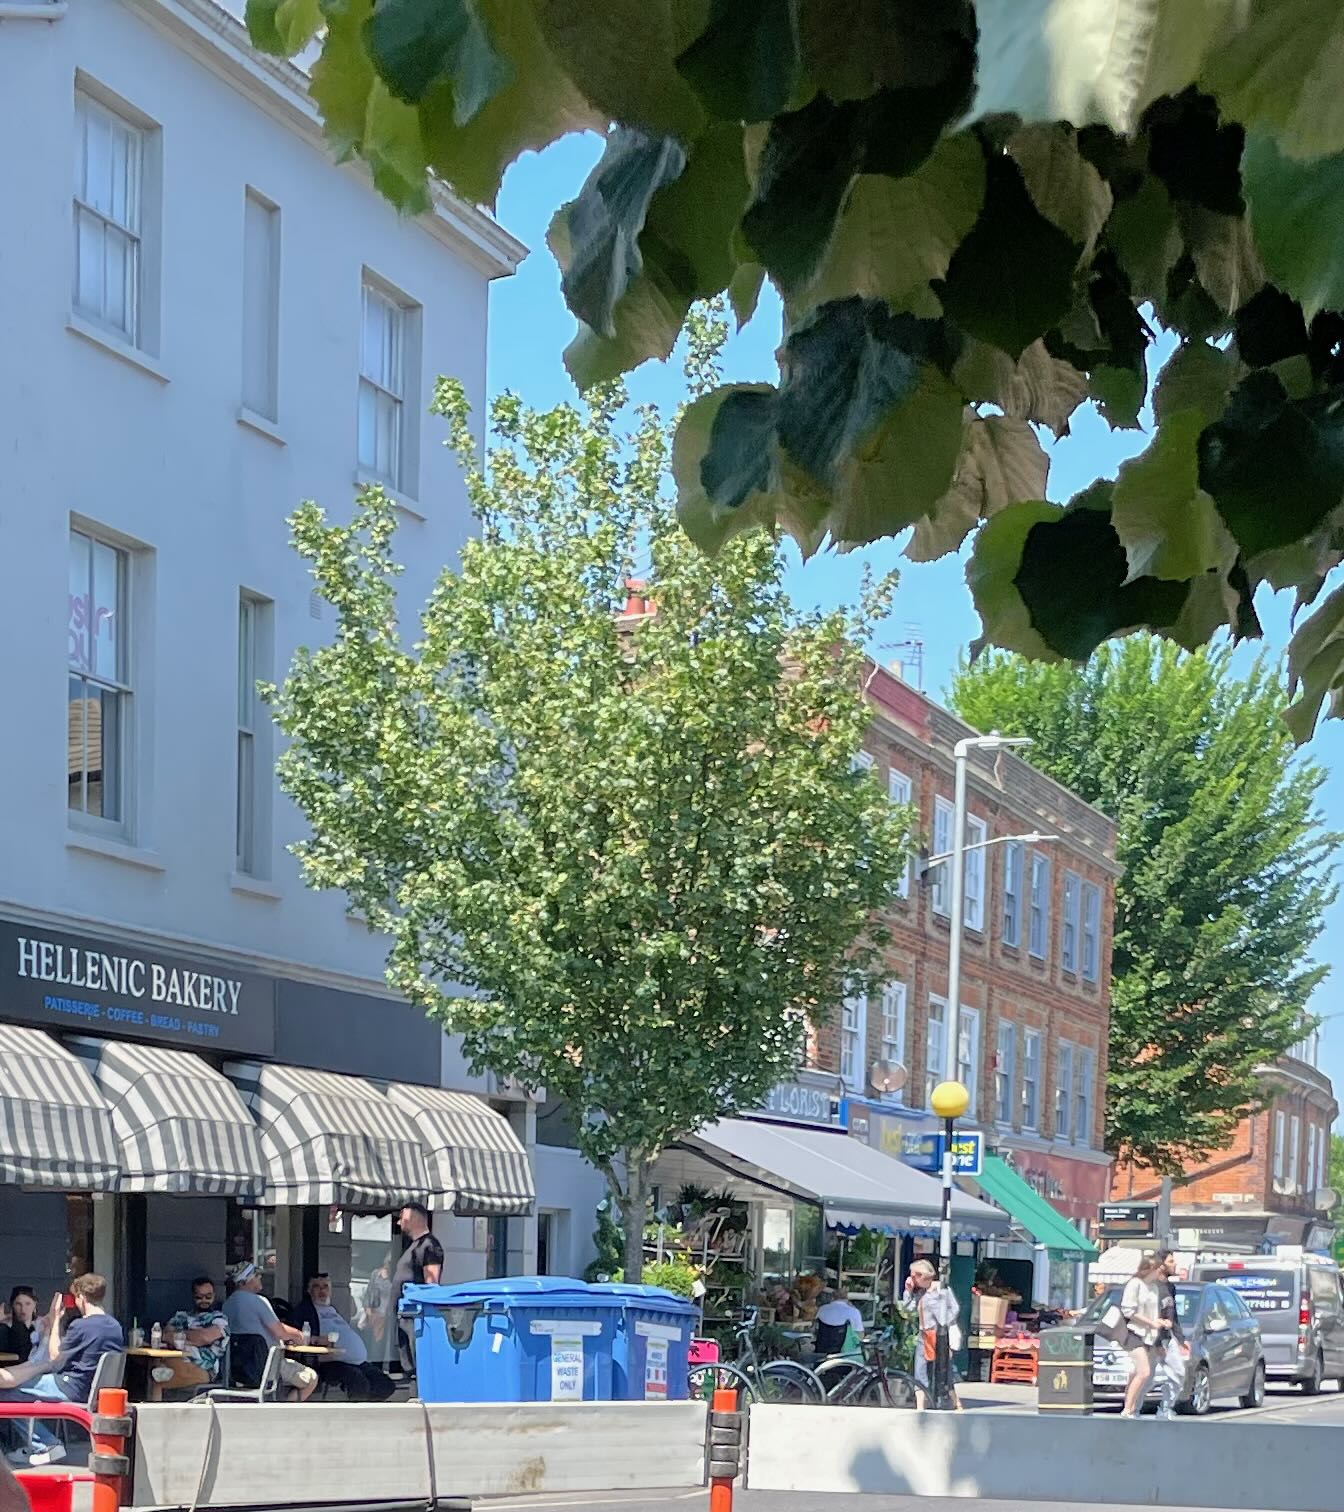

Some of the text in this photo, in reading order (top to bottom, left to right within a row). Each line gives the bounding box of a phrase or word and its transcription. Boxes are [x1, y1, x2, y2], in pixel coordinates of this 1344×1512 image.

[17, 937, 242, 1015] HELLENIC BAKERY
[44, 995, 100, 1018] PATISSERIE
[107, 1006, 144, 1025] COFFEE
[187, 1020, 220, 1038] PASTRY
[553, 1352, 581, 1363] GENERAL
[557, 1366, 579, 1377] WASTE
[559, 1380, 576, 1391] ONLY
